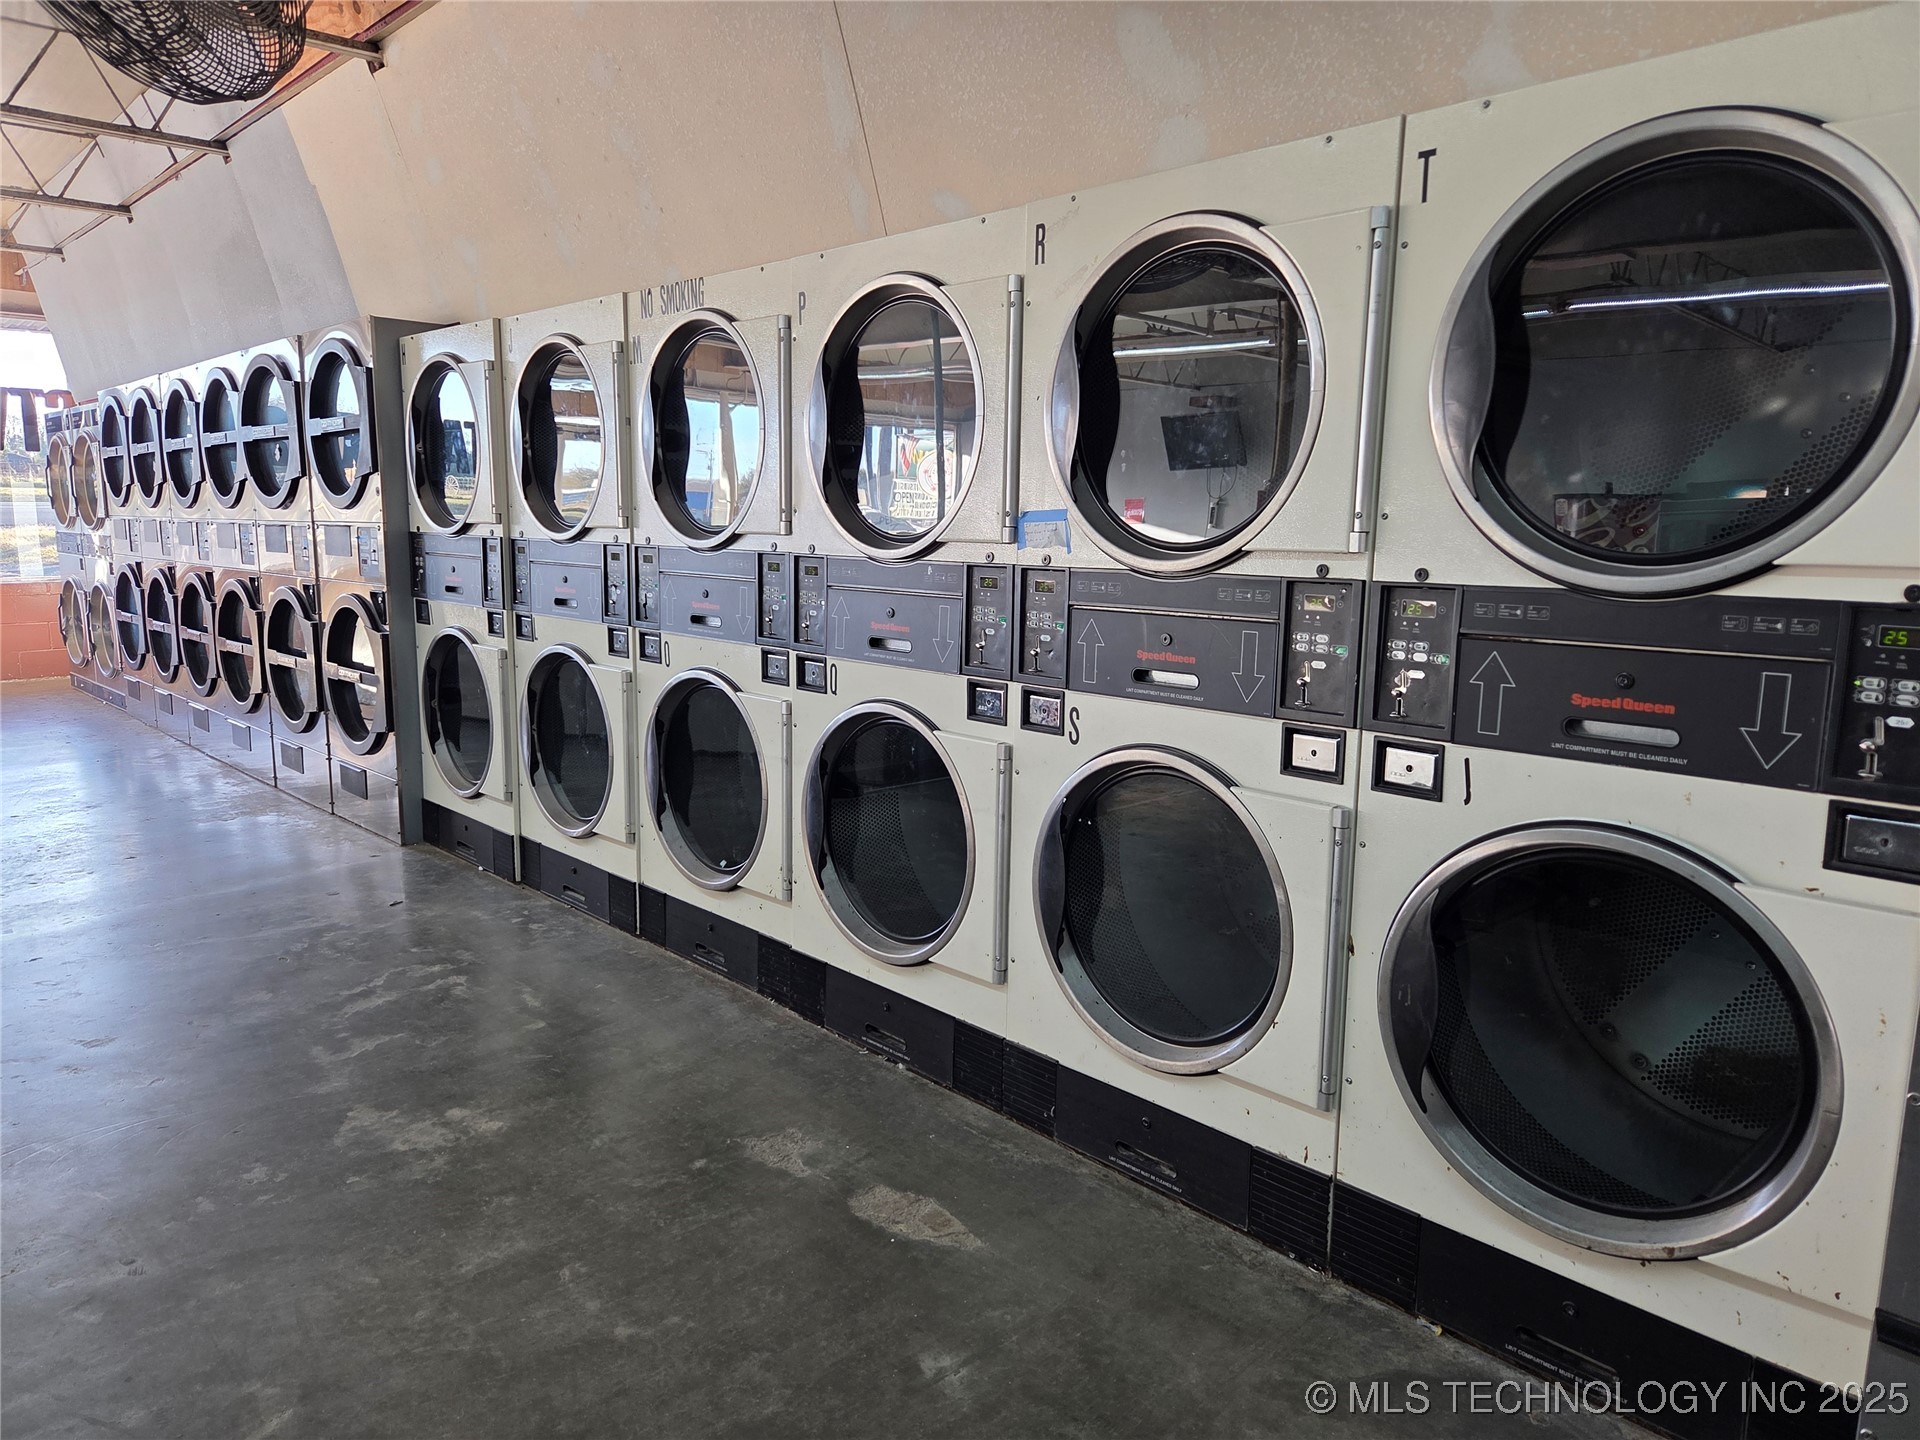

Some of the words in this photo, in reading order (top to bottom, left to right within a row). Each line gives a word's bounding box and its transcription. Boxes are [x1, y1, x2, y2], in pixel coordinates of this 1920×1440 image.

[1418, 148, 1437, 203] T
[1034, 223, 1046, 265] R
[640, 288, 654, 319] NO
[659, 277, 705, 315] SMOKING
[798, 291, 806, 325] P
[632, 335, 643, 365] M
[1407, 604, 1421, 615] 25
[1883, 630, 1909, 645] 25
[1136, 649, 1165, 661] Speed
[1166, 652, 1196, 664] Queen
[1570, 693, 1621, 709] Speed
[1622, 698, 1676, 714] Queen
[1069, 706, 1080, 745] S
[1551, 742, 1564, 750] LINT
[1565, 743, 1610, 756] COMPARTMENT
[1610, 749, 1628, 758] MUST
[1628, 751, 1637, 759] BE
[1638, 752, 1669, 763] CLEANED
[1669, 757, 1689, 765] DAILY
[1517, 1348, 1558, 1372] COMPARTMENT
[1558, 1368, 1575, 1380] MUST
